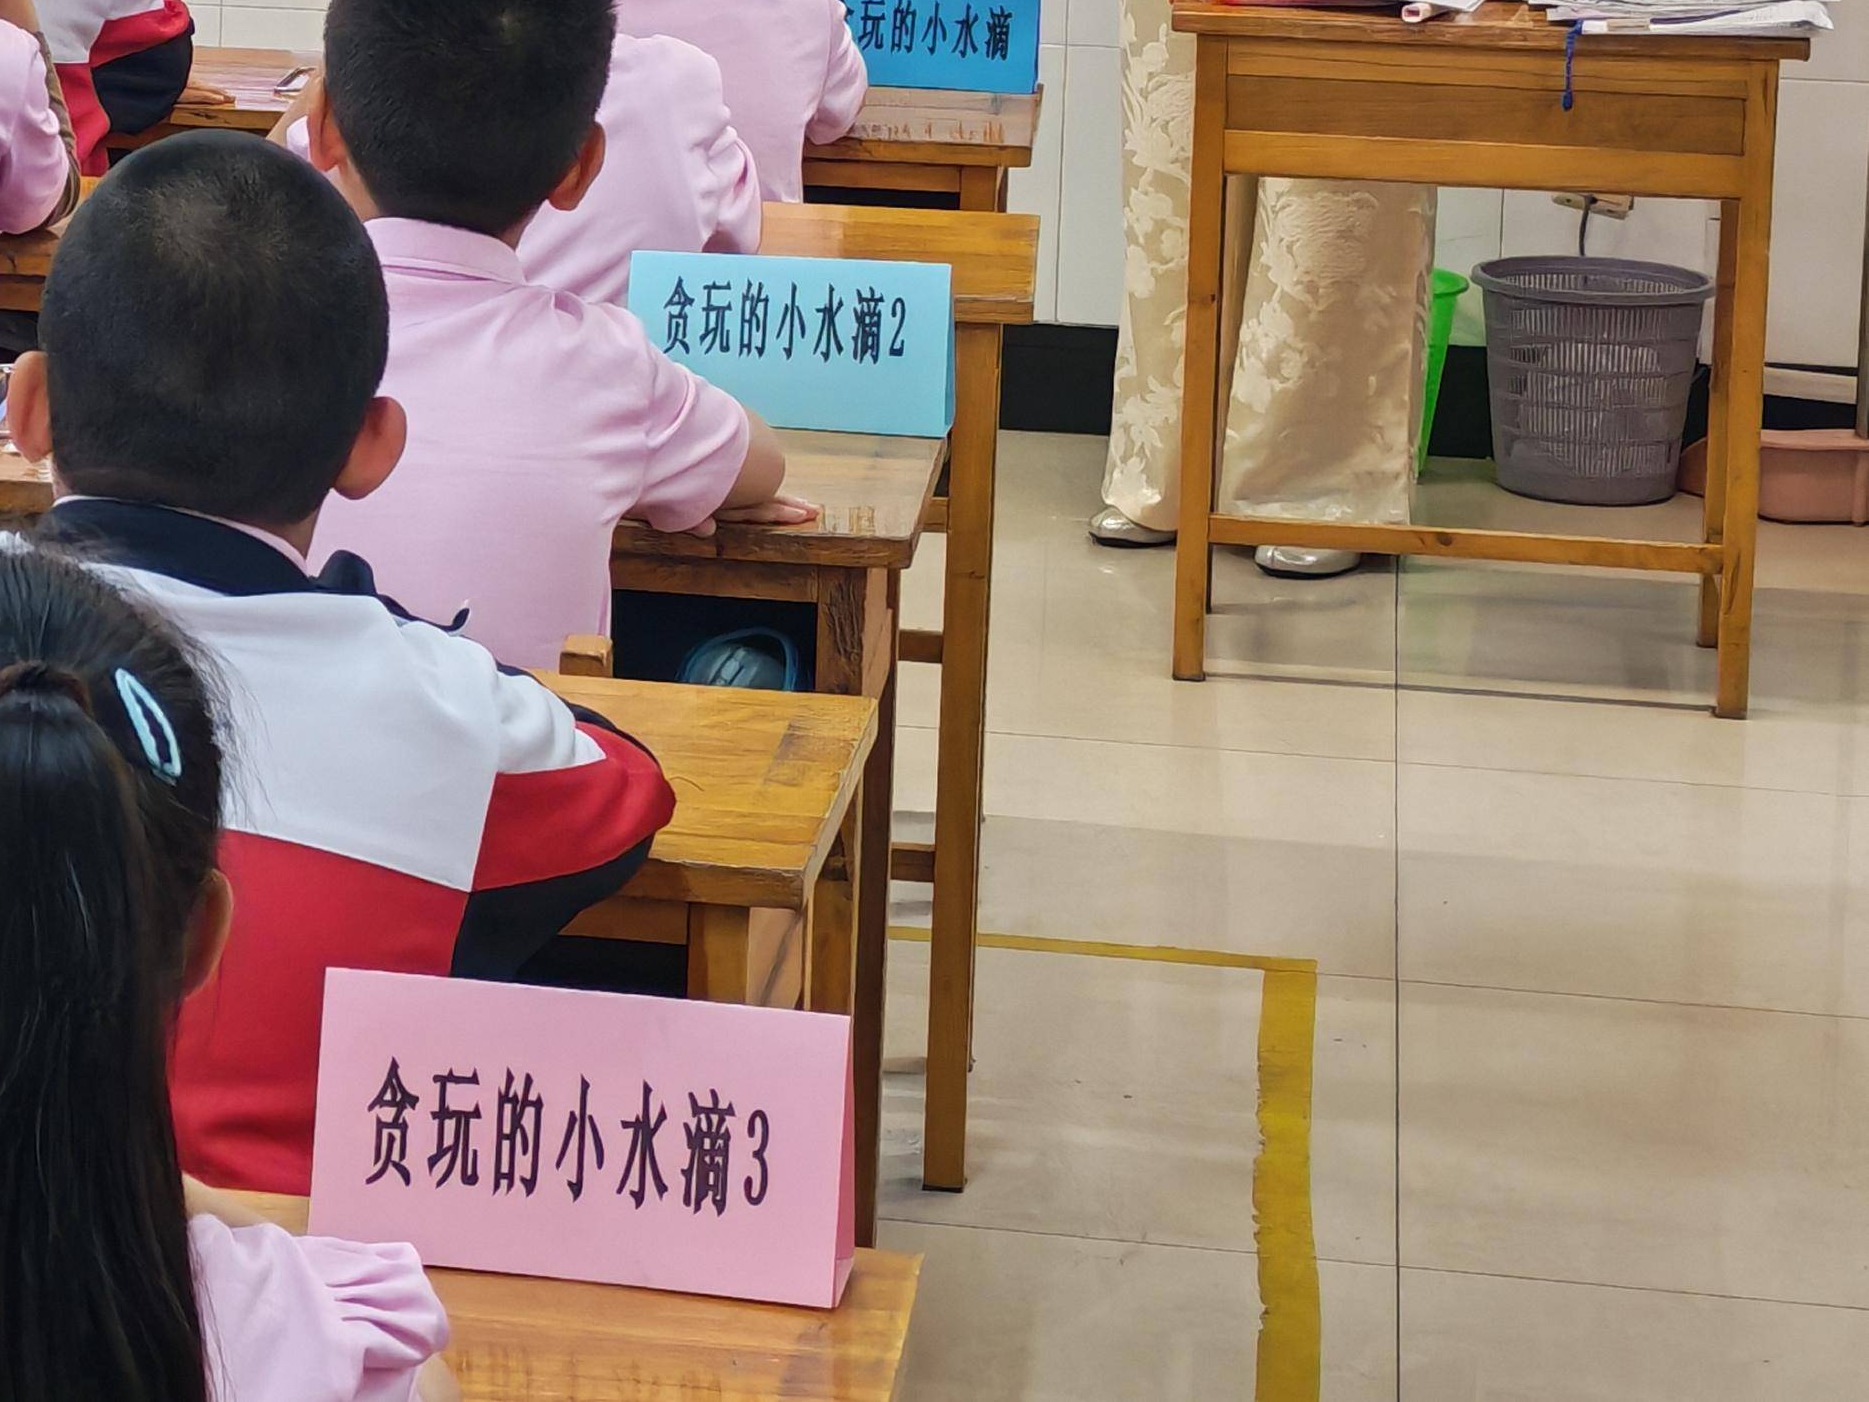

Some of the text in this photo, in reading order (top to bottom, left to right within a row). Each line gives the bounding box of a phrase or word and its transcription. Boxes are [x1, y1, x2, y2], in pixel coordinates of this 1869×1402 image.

[663, 275, 907, 365] 贪玩的小水滴2
[365, 1056, 770, 1217] 贪玩的小水滴3
